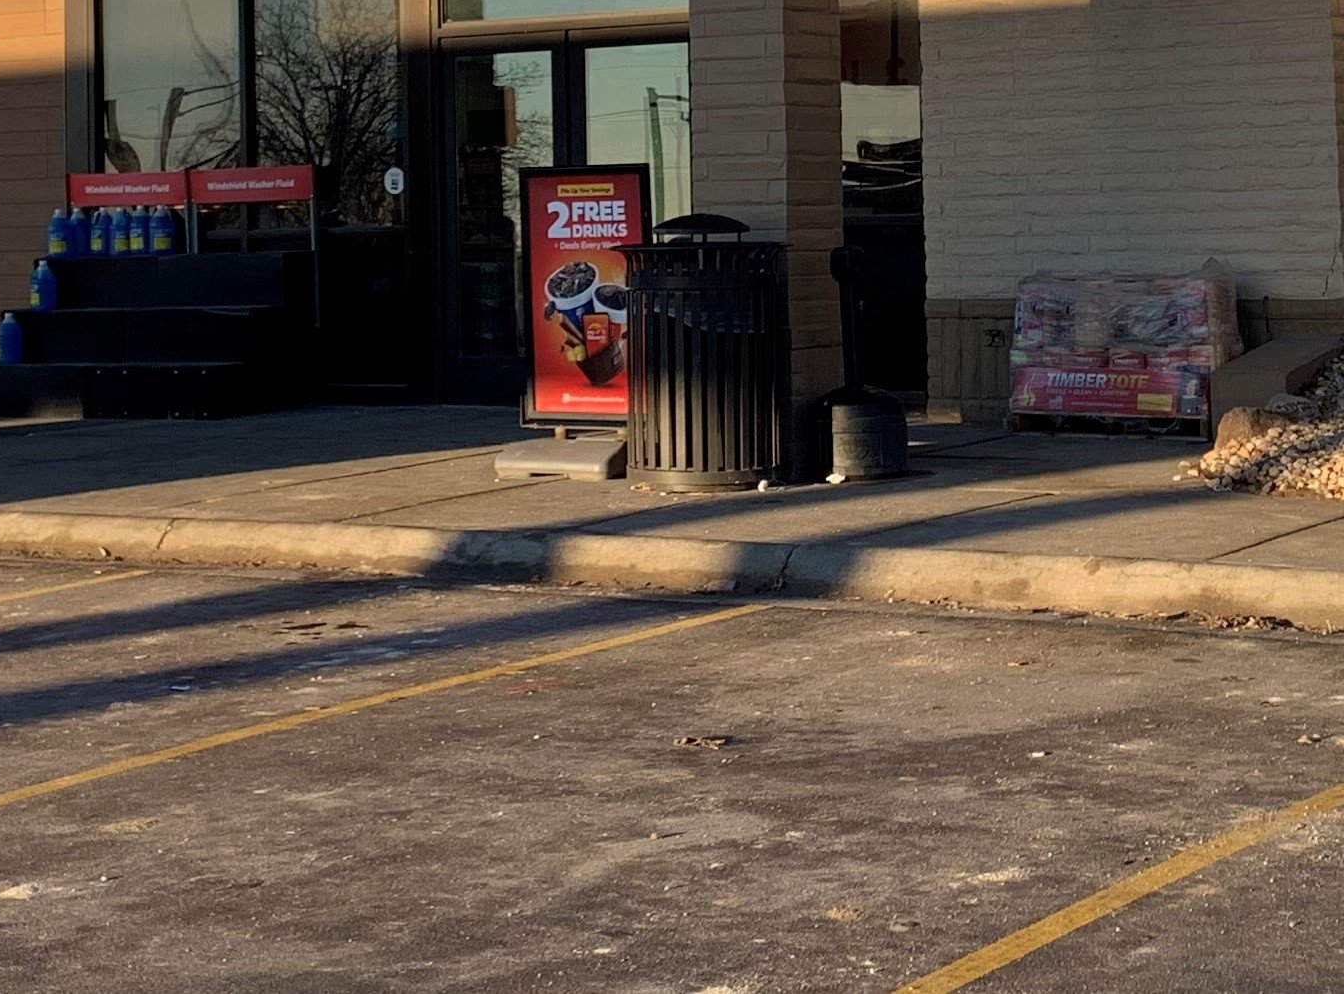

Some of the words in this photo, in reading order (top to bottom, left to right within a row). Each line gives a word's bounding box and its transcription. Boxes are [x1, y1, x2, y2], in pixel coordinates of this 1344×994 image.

[85, 185, 124, 194] Windshield
[125, 184, 151, 193] Washer
[151, 184, 170, 192] Fluid
[207, 181, 247, 190] Windshield
[248, 180, 276, 189] Washer
[277, 179, 295, 188] Fluid
[547, 201, 571, 238] 2
[572, 200, 626, 221] FREE
[573, 223, 628, 237] DRINKS
